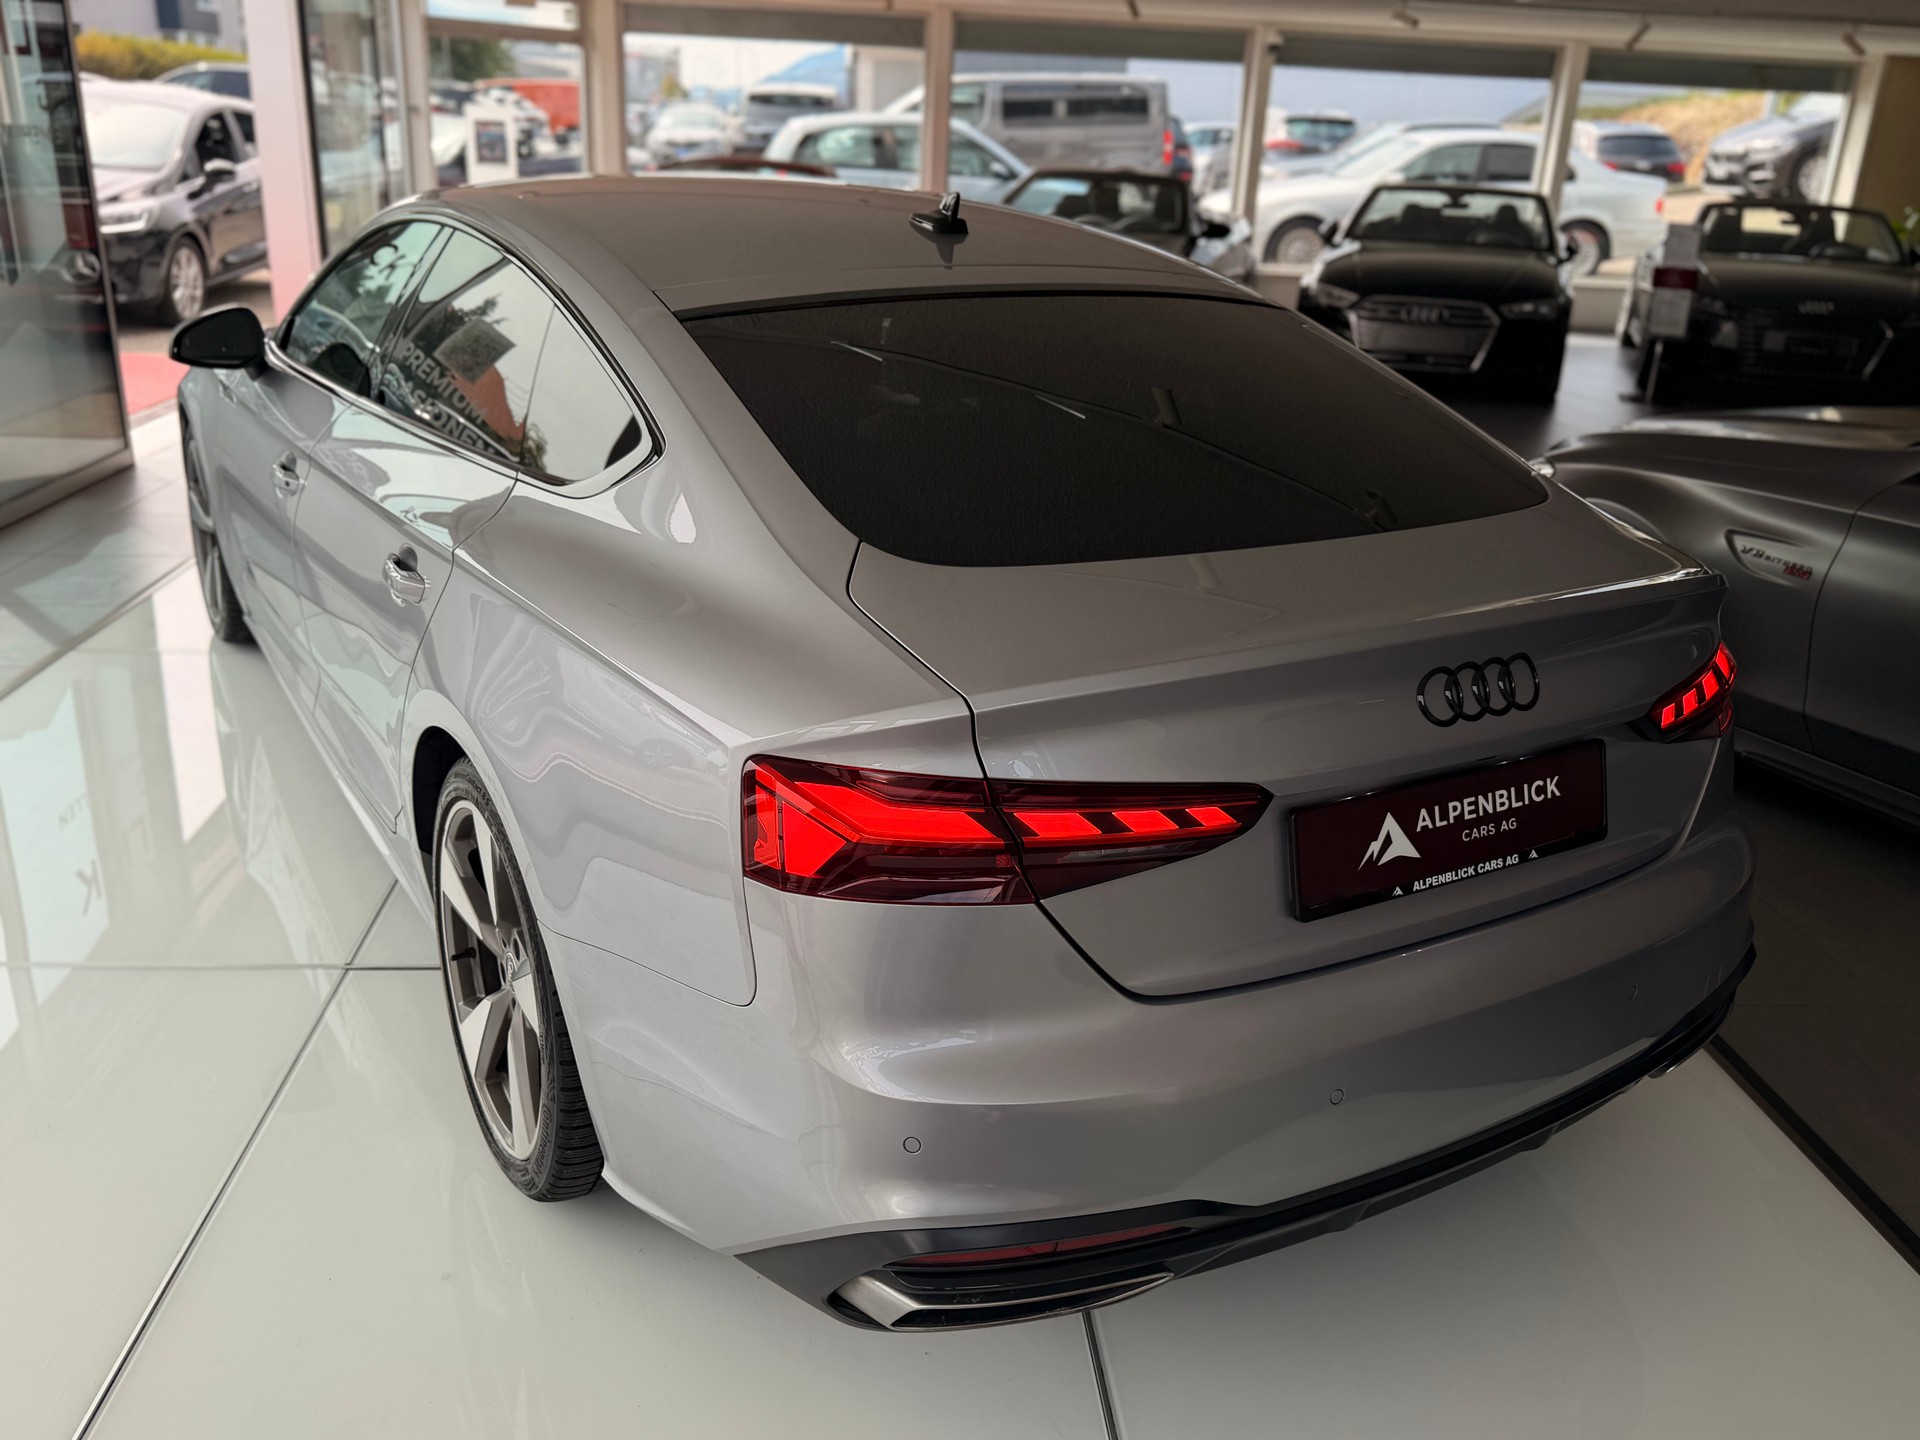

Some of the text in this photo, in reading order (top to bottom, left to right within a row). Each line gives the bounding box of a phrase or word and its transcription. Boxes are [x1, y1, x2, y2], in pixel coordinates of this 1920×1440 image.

[401, 342, 487, 424] PREMIUM
[1415, 775, 1561, 832] ALPENBLICK
[1462, 817, 1518, 842] CARS AG
[1412, 853, 1520, 892] ALPENBLICK CARS AG
